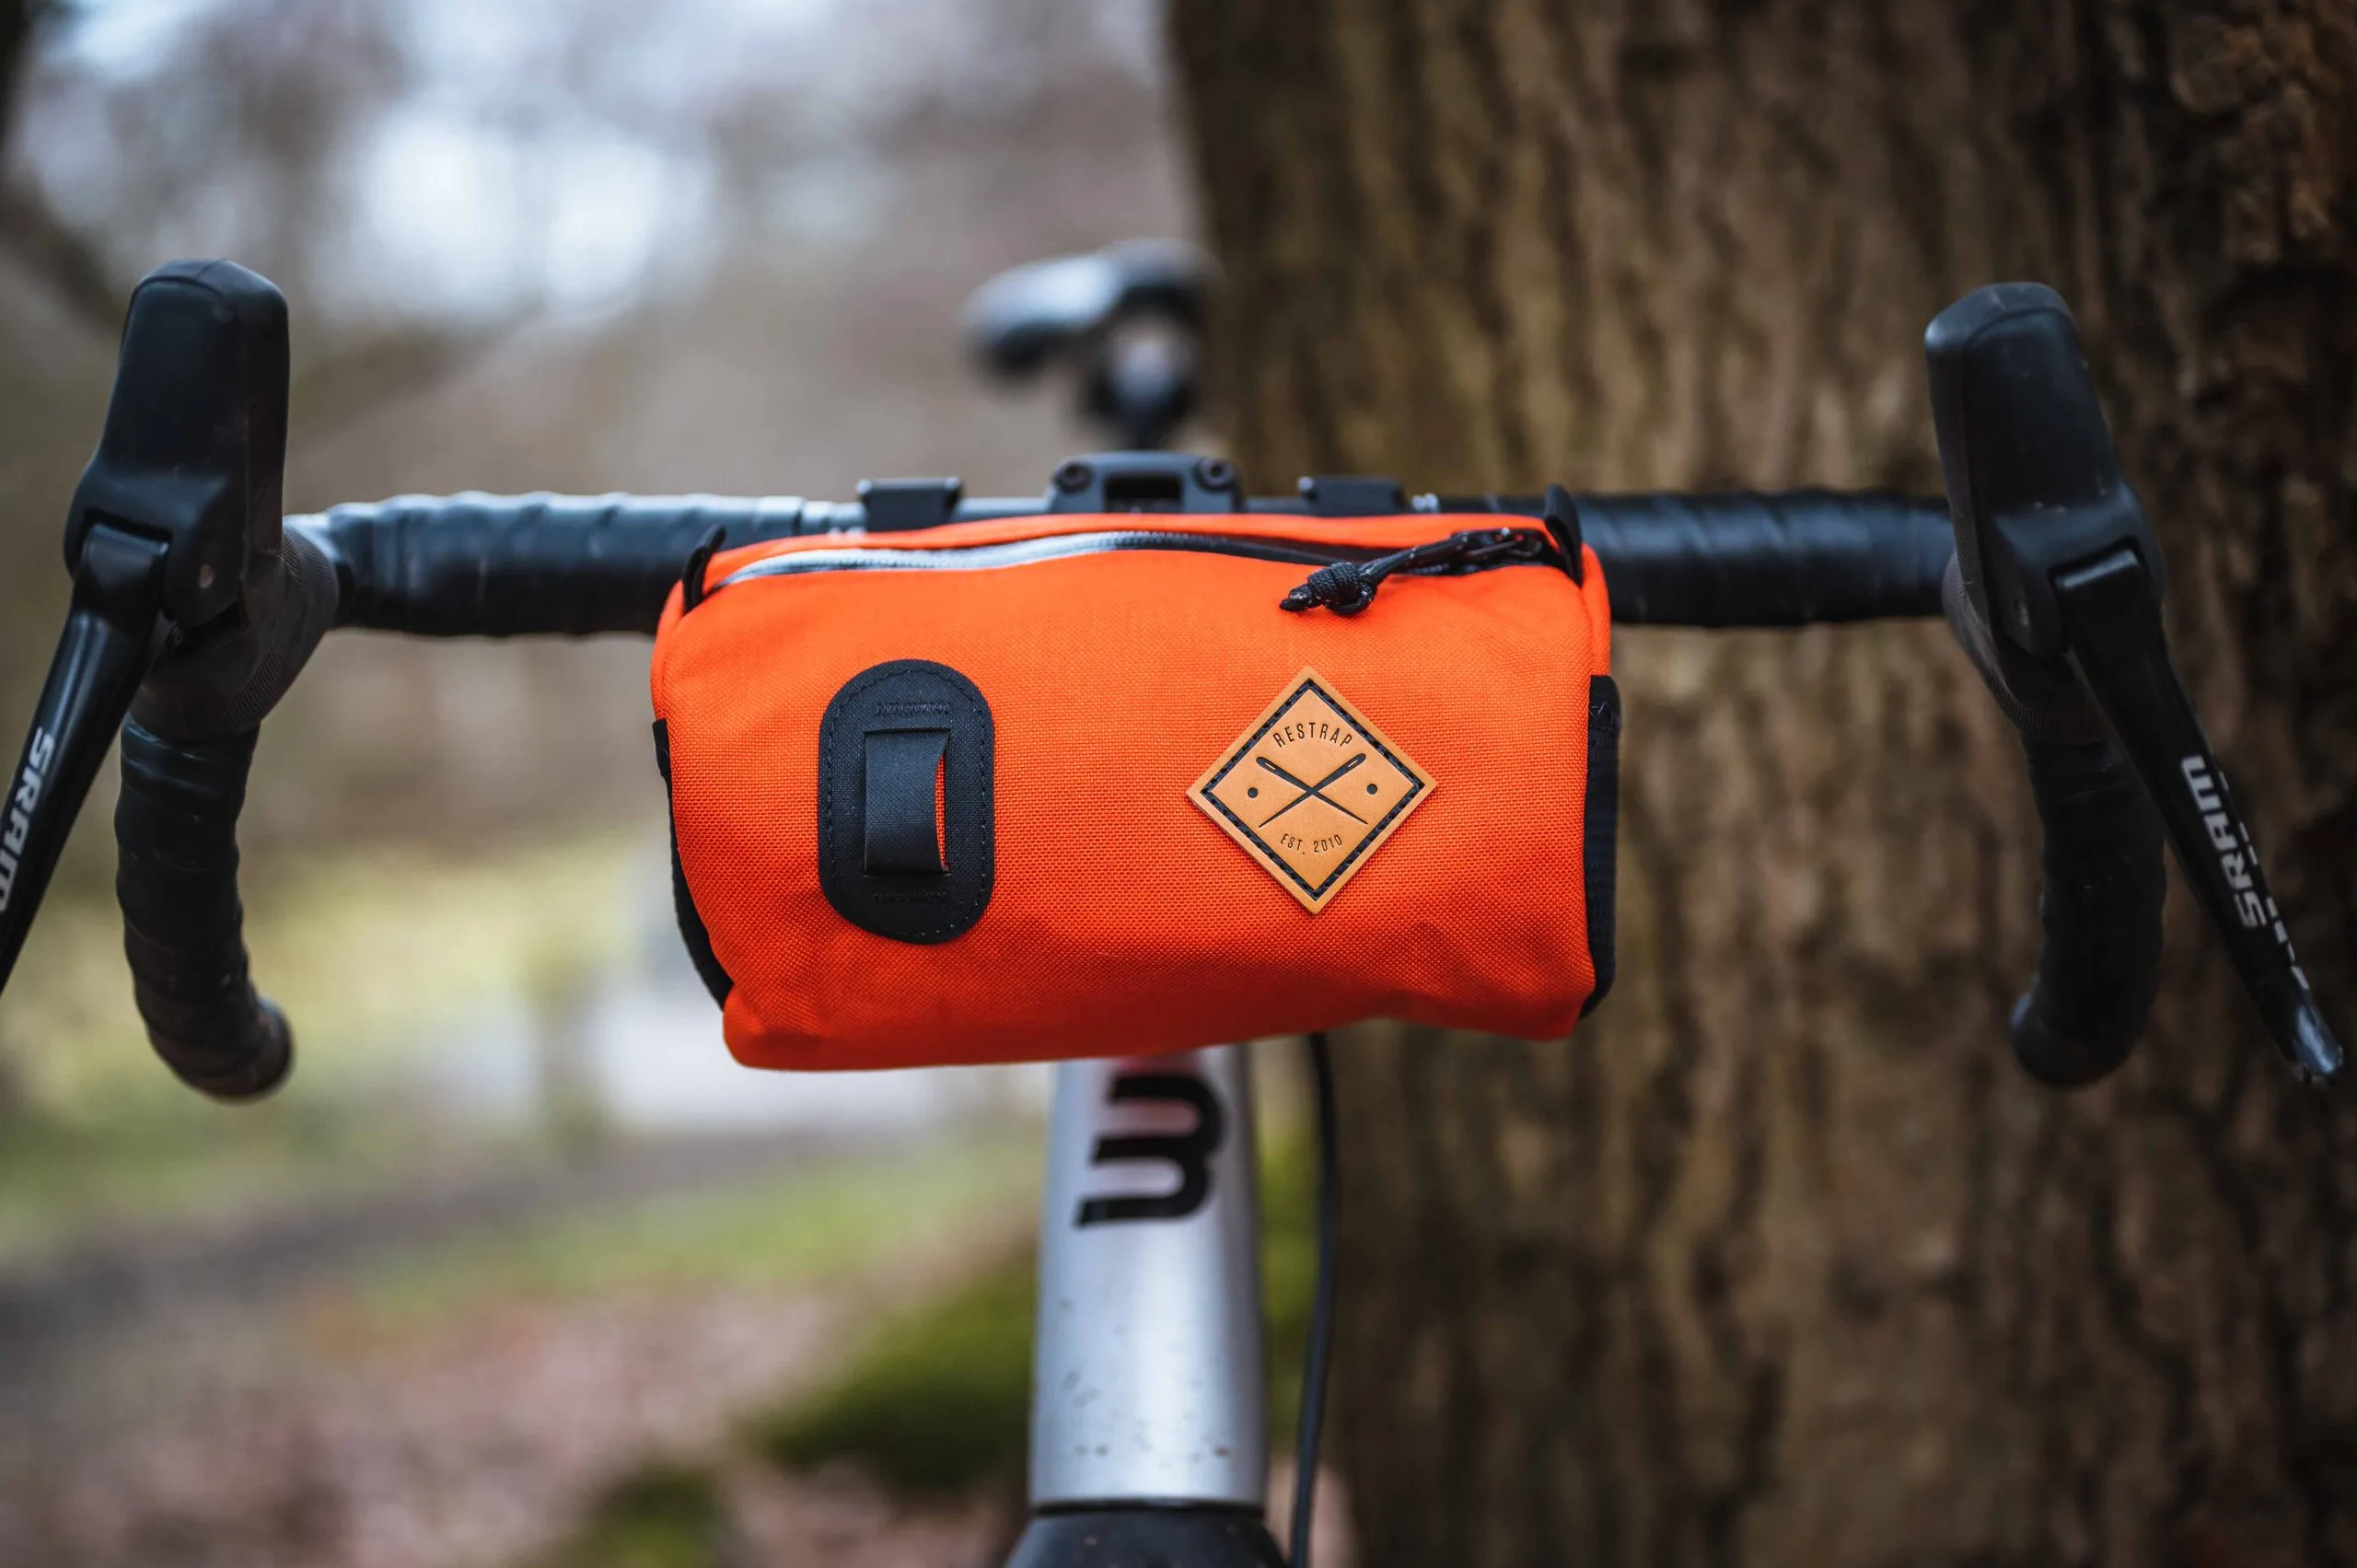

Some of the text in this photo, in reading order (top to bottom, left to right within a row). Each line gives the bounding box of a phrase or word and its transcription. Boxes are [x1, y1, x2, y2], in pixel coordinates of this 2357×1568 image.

[1272, 722, 1353, 748] RESTRAP
[1280, 832, 1342, 855] EST. 2010
[2180, 754, 2268, 928] SRAM
